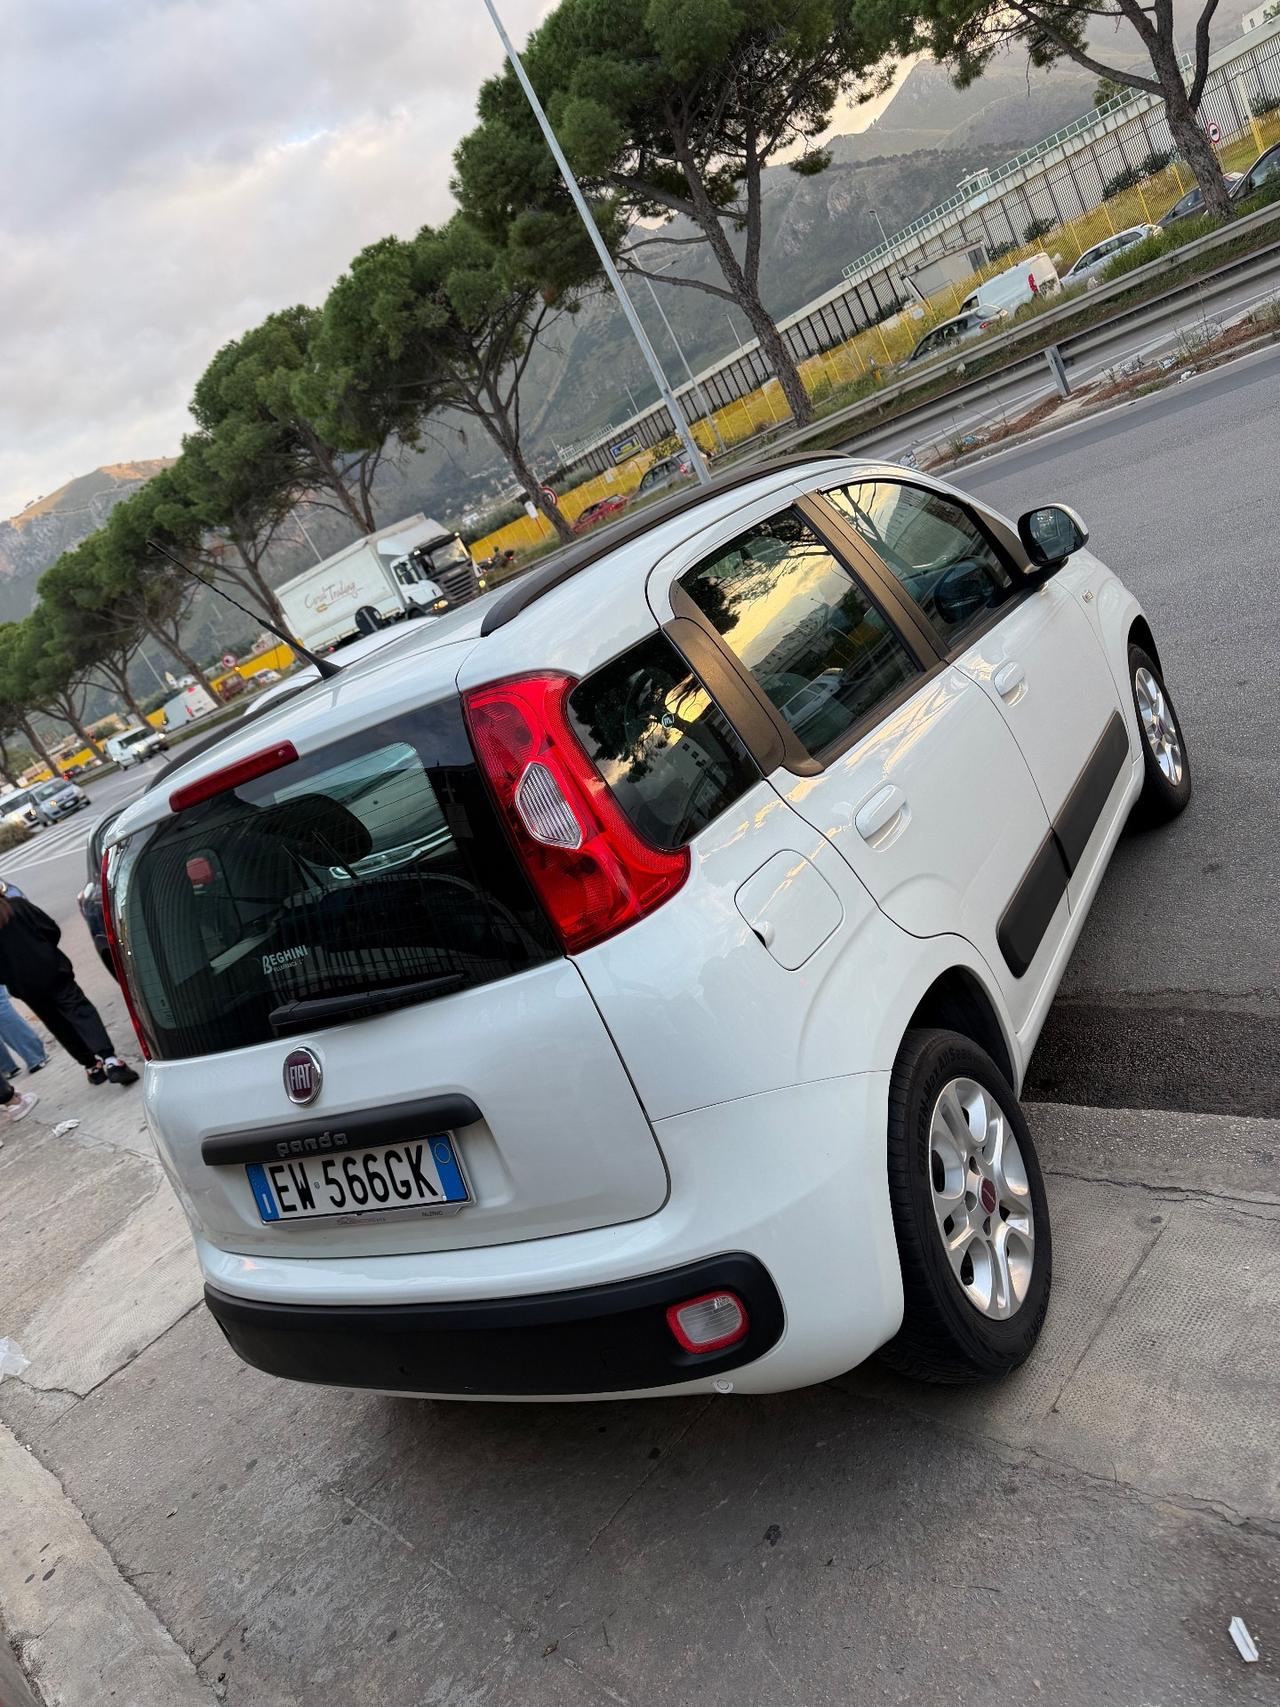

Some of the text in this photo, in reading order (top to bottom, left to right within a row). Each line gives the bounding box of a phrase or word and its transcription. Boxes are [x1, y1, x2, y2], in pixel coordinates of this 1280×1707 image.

[262, 944, 309, 975] BEGHINI
[290, 1063, 311, 1090] FIAT
[277, 1132, 348, 1157] panda
[268, 1162, 316, 1213] EW
[322, 1144, 438, 1208] 566GK
